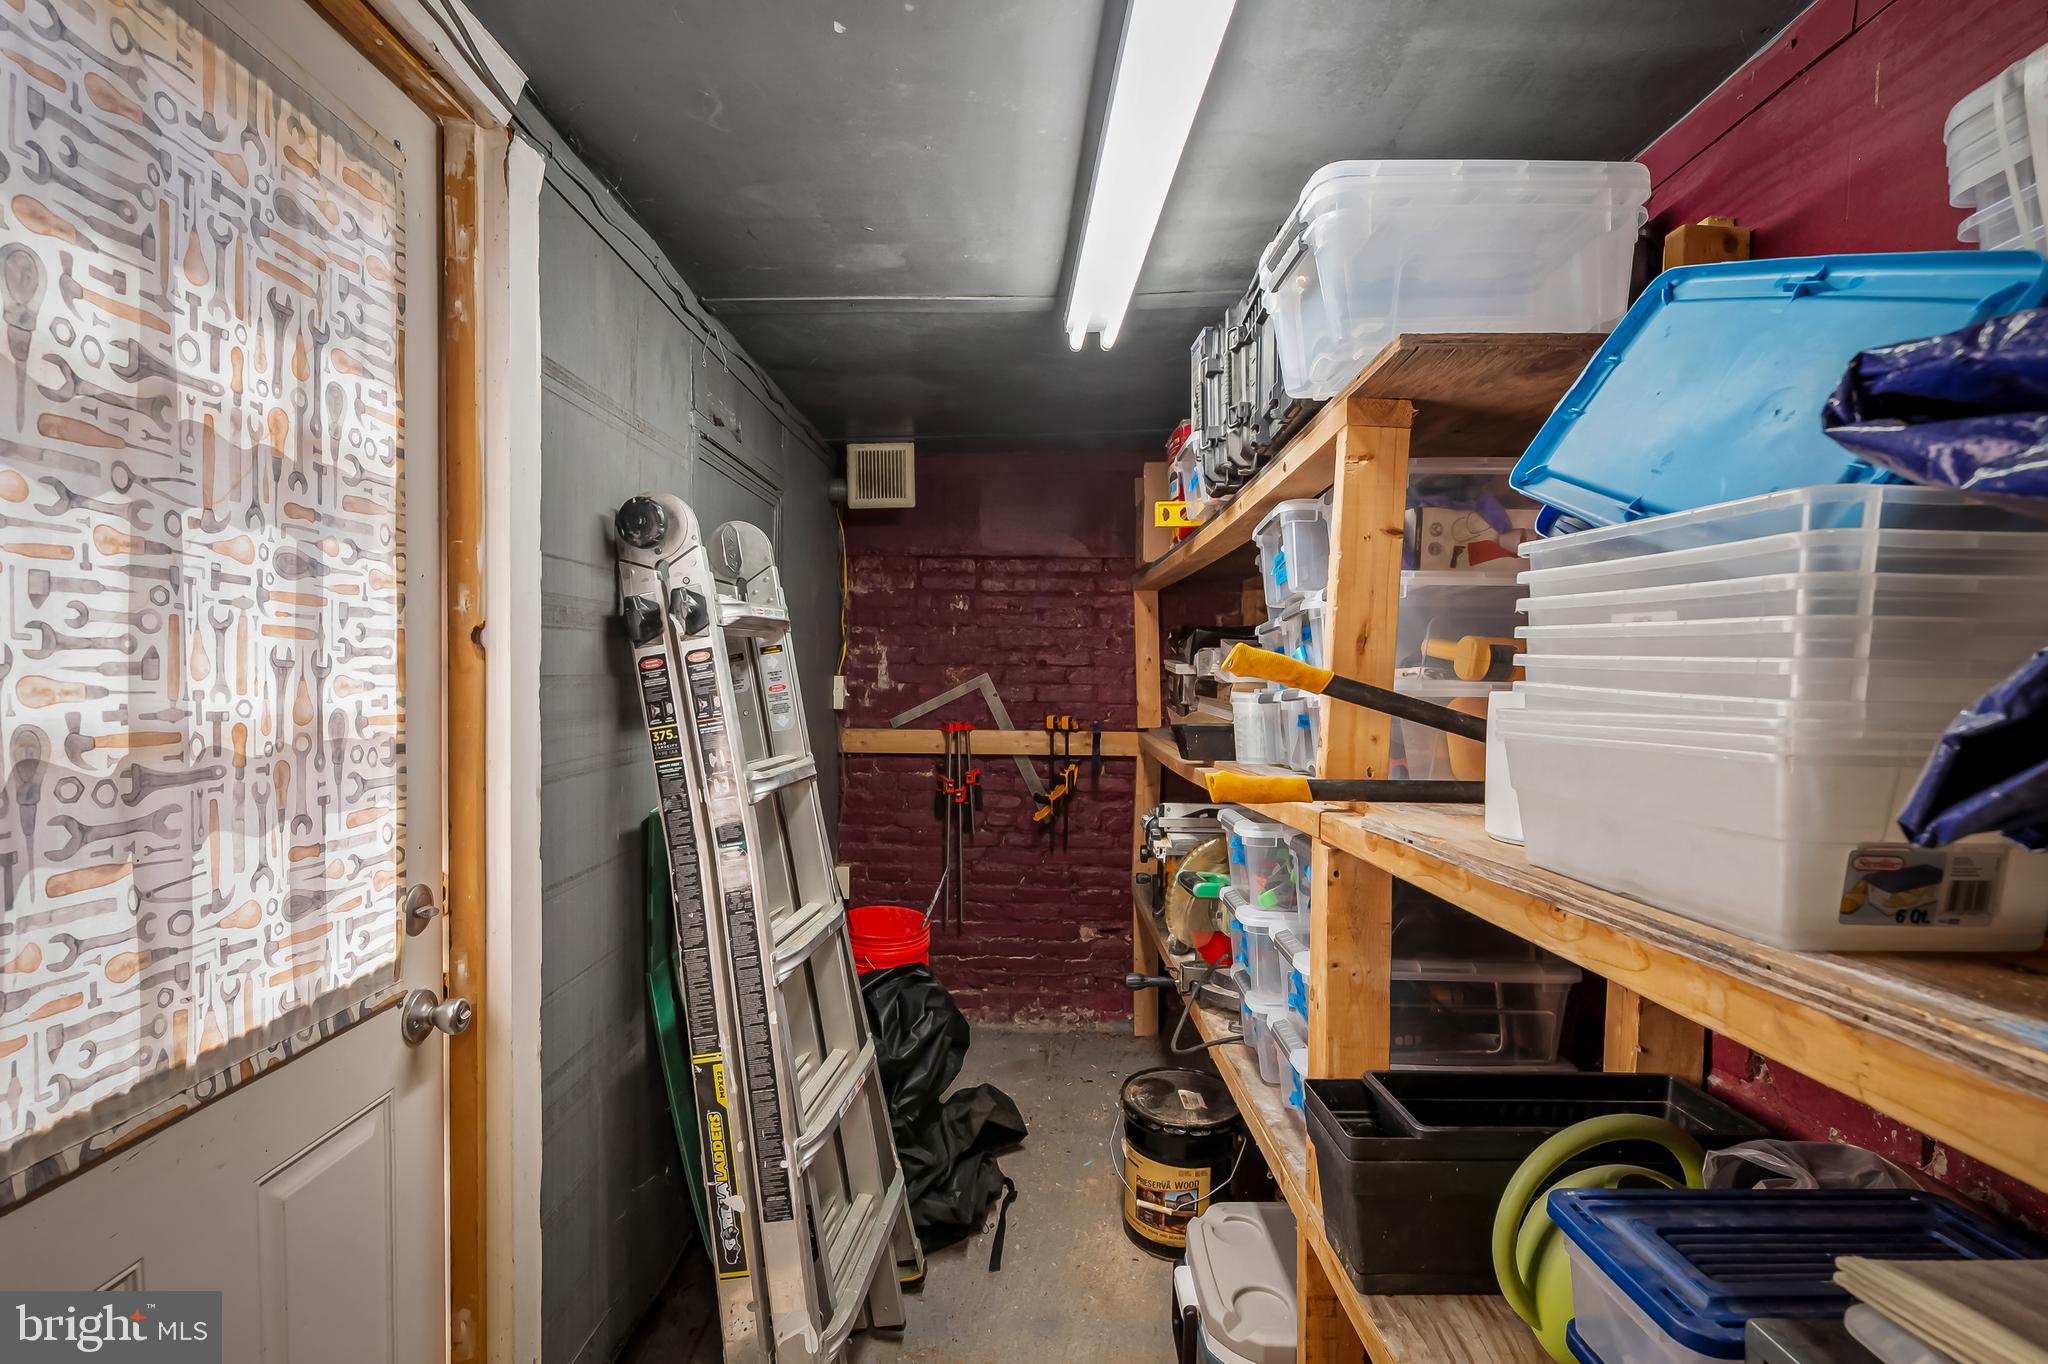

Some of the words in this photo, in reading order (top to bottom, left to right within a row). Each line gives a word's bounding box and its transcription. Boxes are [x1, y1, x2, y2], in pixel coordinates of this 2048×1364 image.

[651, 729, 673, 742] 375
[1895, 909, 1905, 923] 6
[717, 1071, 726, 1098] MPX22
[708, 1113, 728, 1182] LADDERS
[1174, 1180, 1200, 1190] WOOD
